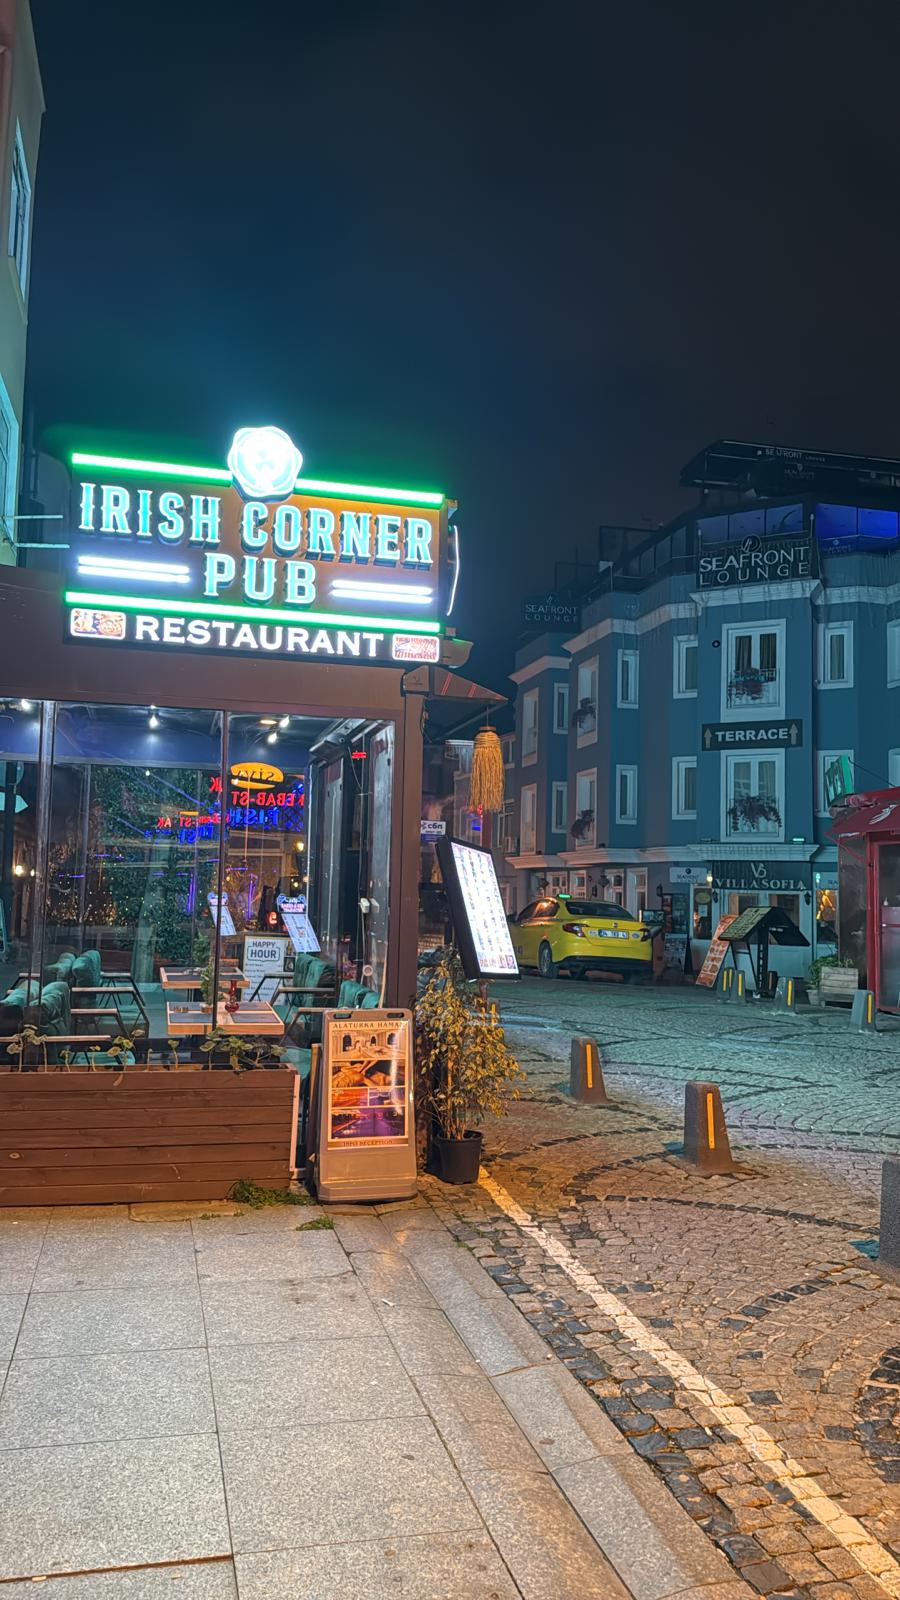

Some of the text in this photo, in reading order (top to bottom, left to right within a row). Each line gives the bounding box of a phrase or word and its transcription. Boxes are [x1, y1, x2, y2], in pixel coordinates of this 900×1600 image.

[79, 481, 434, 564] IRISH CORNER
[700, 546, 809, 573] SEAFRONT
[203, 552, 318, 605] PUB
[700, 562, 809, 585] LOUNGE
[525, 604, 577, 615] SEAFRONT
[135, 616, 384, 658] RESTAURANT
[715, 727, 789, 742] TERRACE
[715, 879, 806, 889] VILLA SOFIA
[250, 949, 277, 958] HOUR
